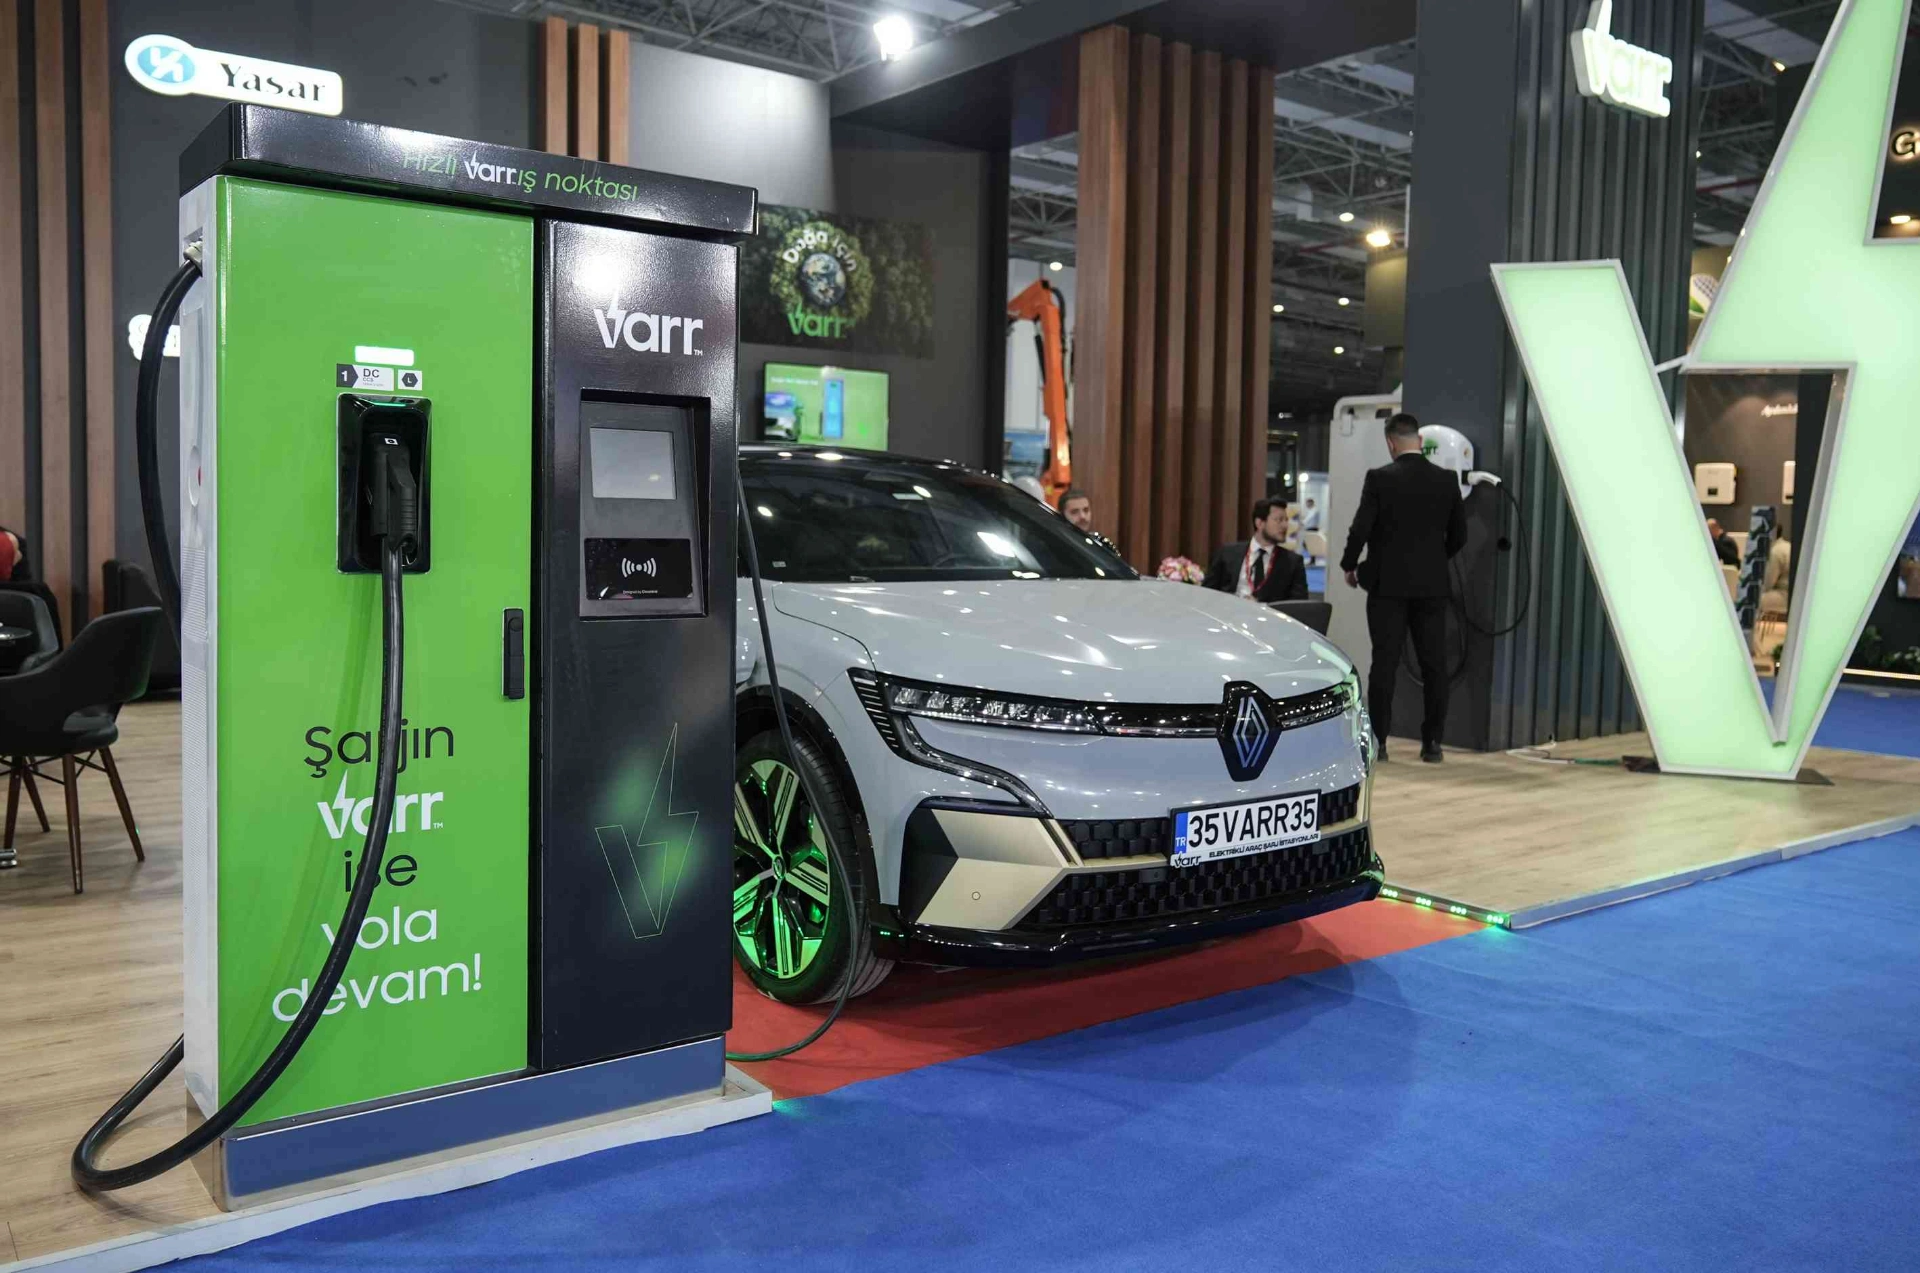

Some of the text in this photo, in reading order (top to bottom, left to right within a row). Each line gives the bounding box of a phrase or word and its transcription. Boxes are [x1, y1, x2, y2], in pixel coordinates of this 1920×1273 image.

[544, 172, 639, 201] noktası
[783, 228, 828, 264] Doğa
[341, 370, 348, 382] 1
[363, 368, 380, 378] DC
[304, 718, 454, 778] Şajın
[1175, 836, 1187, 846] TR
[344, 850, 418, 893] ie
[272, 953, 482, 1022] devam!
